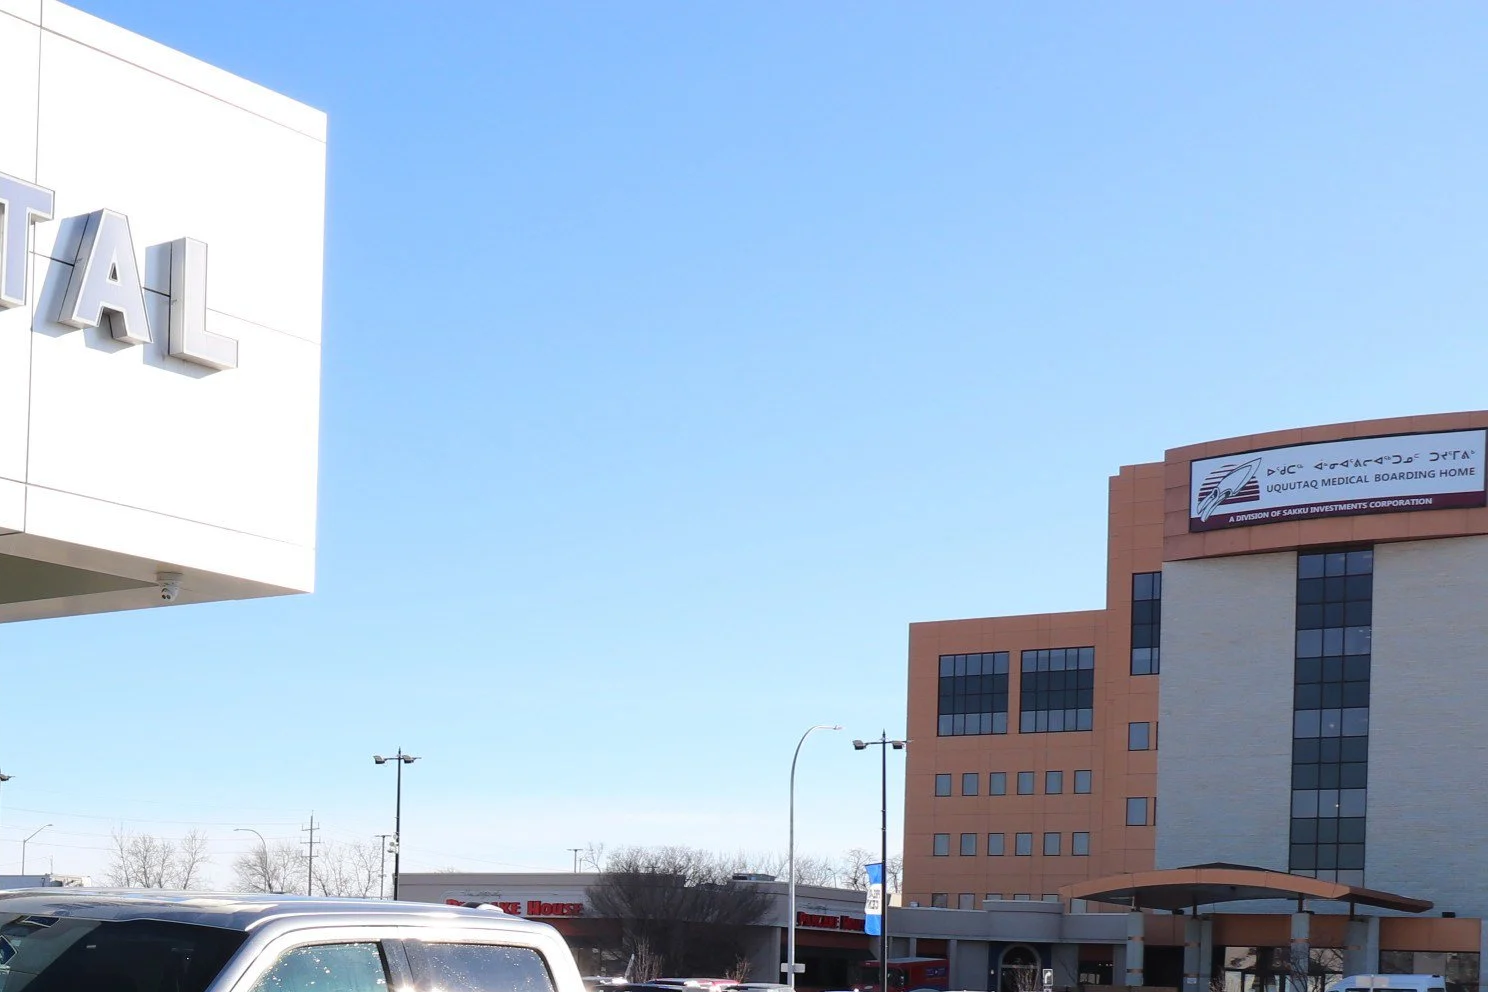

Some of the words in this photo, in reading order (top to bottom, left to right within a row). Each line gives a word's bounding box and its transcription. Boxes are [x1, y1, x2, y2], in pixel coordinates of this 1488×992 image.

[1266, 479, 1319, 494] UQUUTAQ
[1321, 475, 1370, 487] MEDICAL
[1374, 469, 1436, 482] BOARDING
[1439, 466, 1476, 478] HOME
[1228, 516, 1236, 524] A
[1235, 511, 1270, 523] DIVISION
[1271, 509, 1282, 518] OF
[1282, 506, 1309, 517] SAKKU
[1310, 502, 1368, 514] INVESTMENTS
[1369, 497, 1433, 509] CORPORATION
[527, 900, 585, 916] HOUSE
